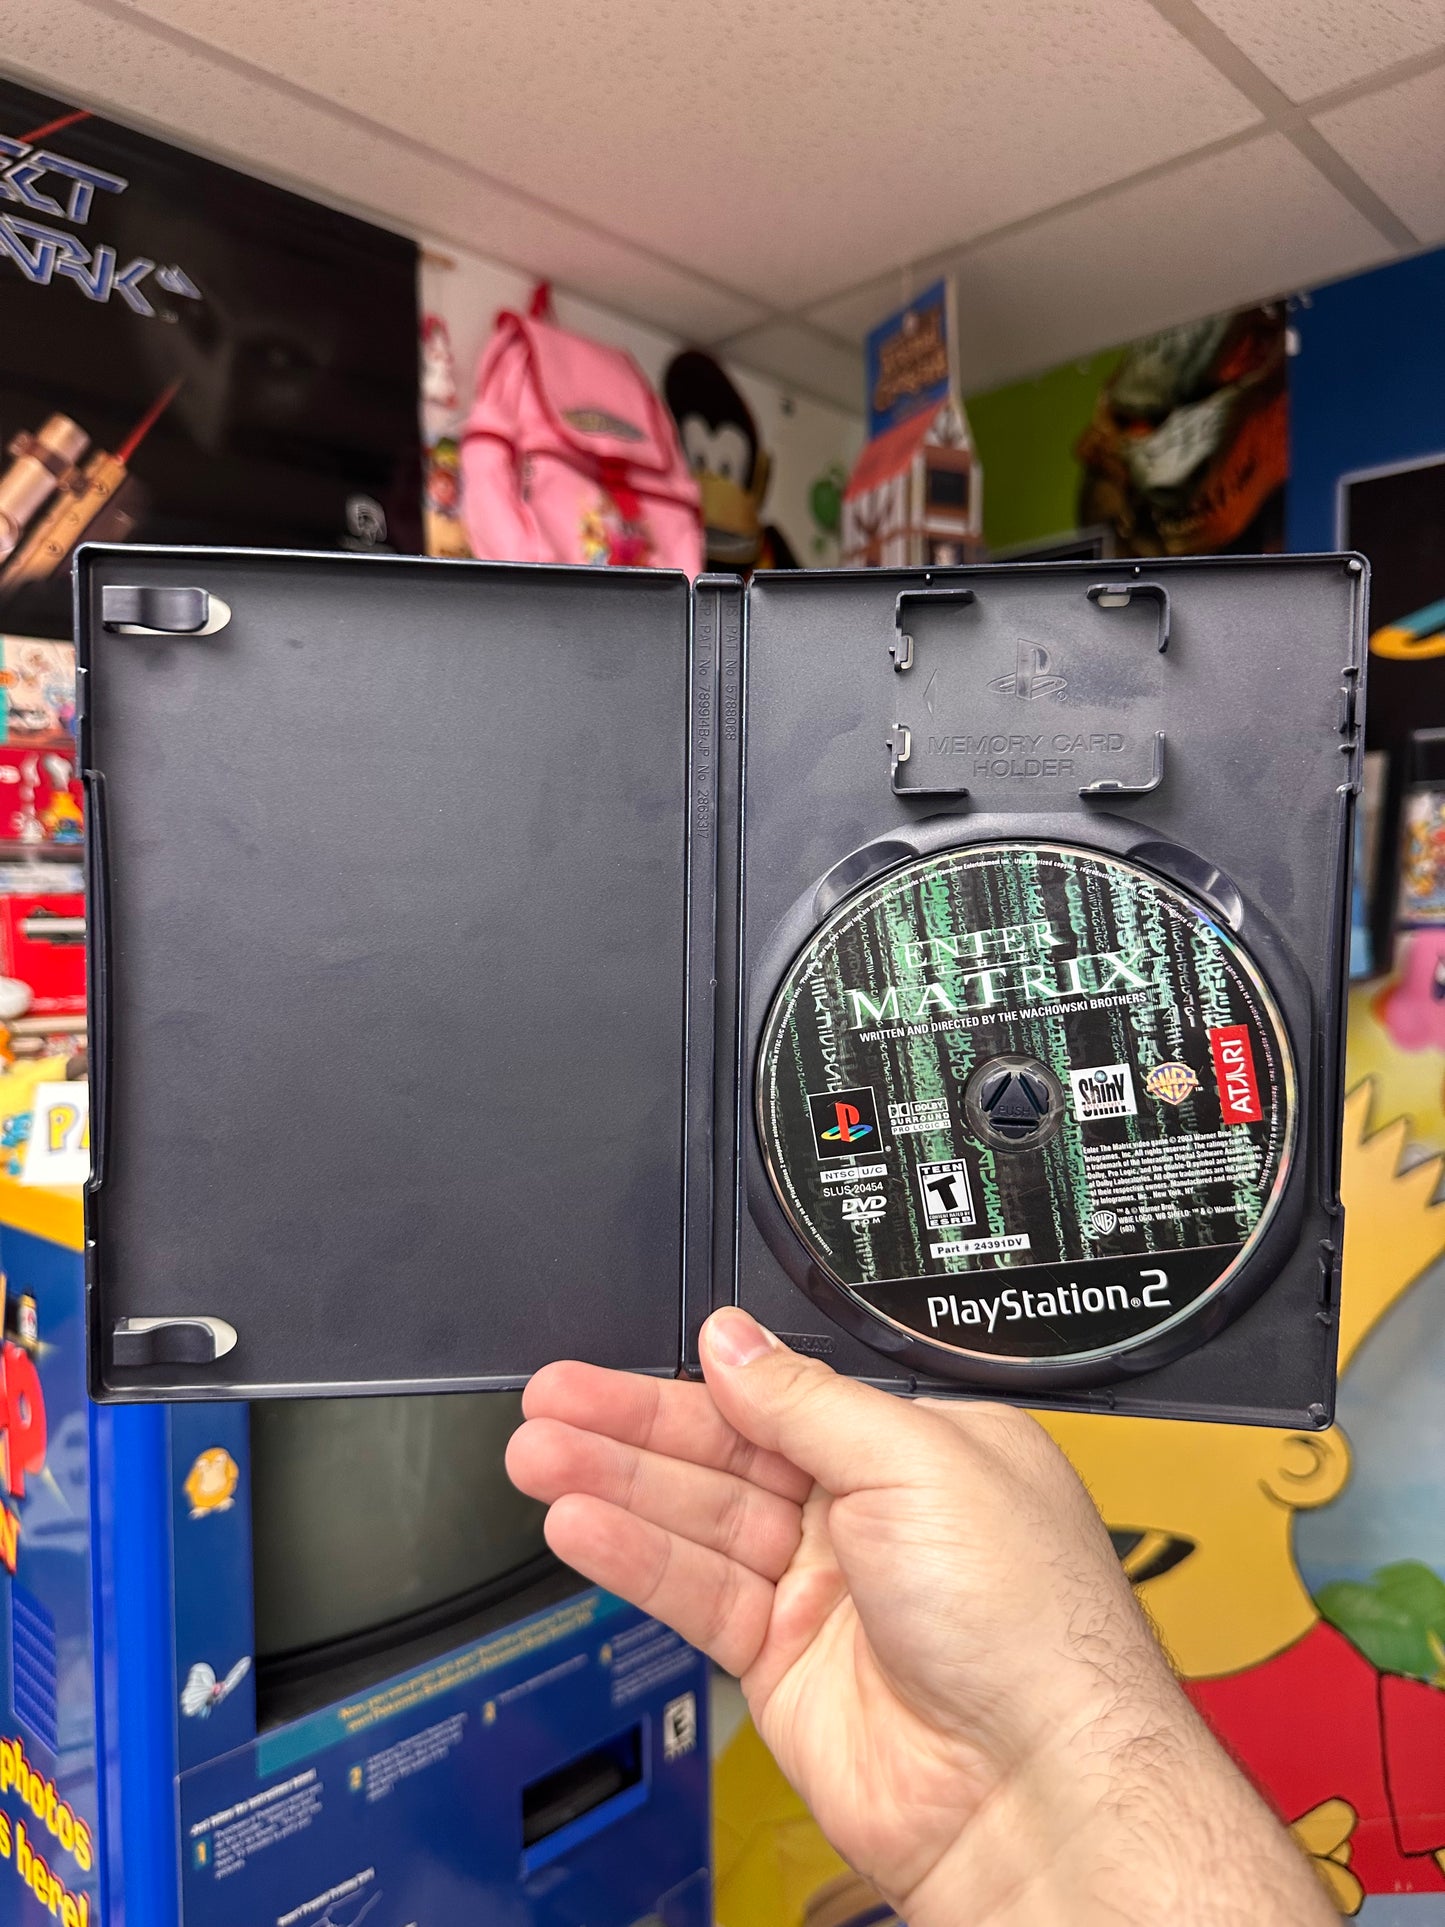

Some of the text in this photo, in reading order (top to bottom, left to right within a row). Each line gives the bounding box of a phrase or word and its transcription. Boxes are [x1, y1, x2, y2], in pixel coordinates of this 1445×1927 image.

[928, 733, 1126, 755] MEMORY CARD
[973, 759, 1075, 778] HOLDER
[902, 921, 1064, 969] ENTER
[847, 949, 1157, 1029] MATRIX
[859, 991, 1145, 1043] WRITTEN AND DIRECTED BY THE WACHOWSKI BROTHERS
[1220, 1039, 1254, 1114] ATARI
[914, 1101, 943, 1112] DOLBY
[999, 1105, 1031, 1116] PUSH
[890, 1112, 950, 1126] SURROUND
[893, 1125, 911, 1134] PRO
[913, 1122, 941, 1131] LOGIC
[1083, 1145, 1099, 1154] Enter
[1099, 1143, 1111, 1152] The
[1176, 1133, 1192, 1143] 2003
[825, 1166, 884, 1180] NTSC U/C
[921, 1163, 963, 1175] TEEN
[927, 1174, 959, 1211] T
[842, 1195, 887, 1213] DVD
[854, 1218, 881, 1226] ROM
[930, 1215, 972, 1227] ESRB
[937, 1244, 960, 1255] Part
[974, 1238, 1023, 1251] 24391DV
[927, 1282, 1131, 1333] PlayStation
[0, 1736, 94, 1872] photos
